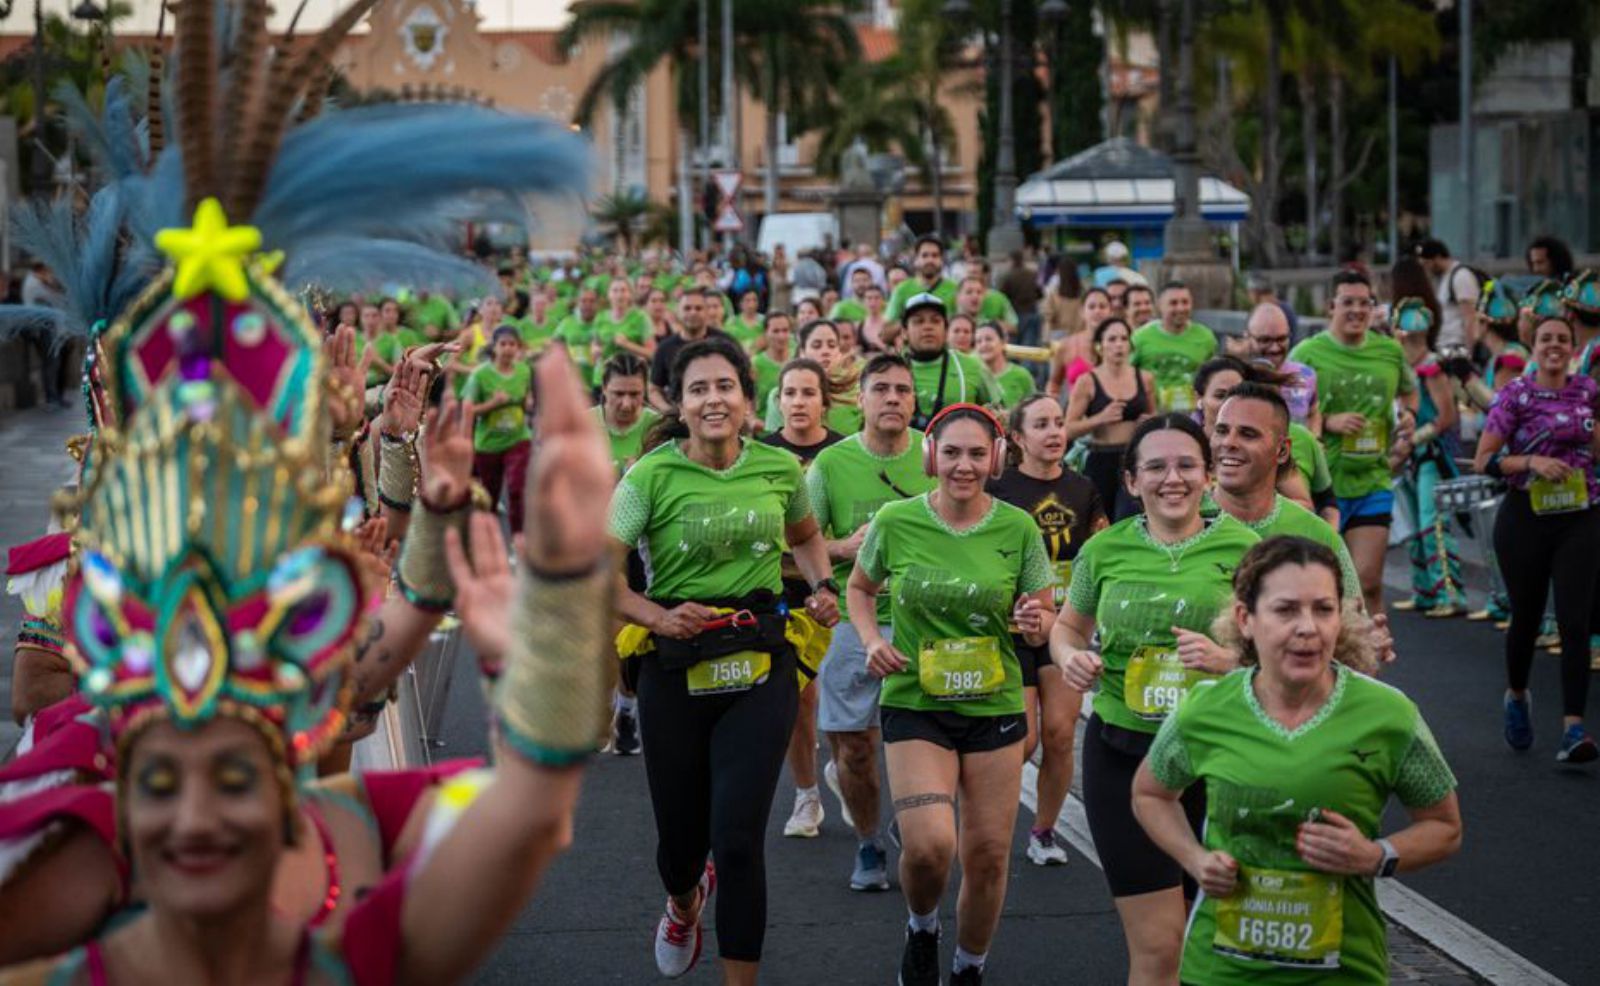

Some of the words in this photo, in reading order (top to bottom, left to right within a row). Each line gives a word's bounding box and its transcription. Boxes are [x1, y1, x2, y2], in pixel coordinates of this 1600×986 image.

[710, 660, 752, 682] 7564
[944, 671, 983, 689] 7982
[1240, 917, 1313, 951] F6582
